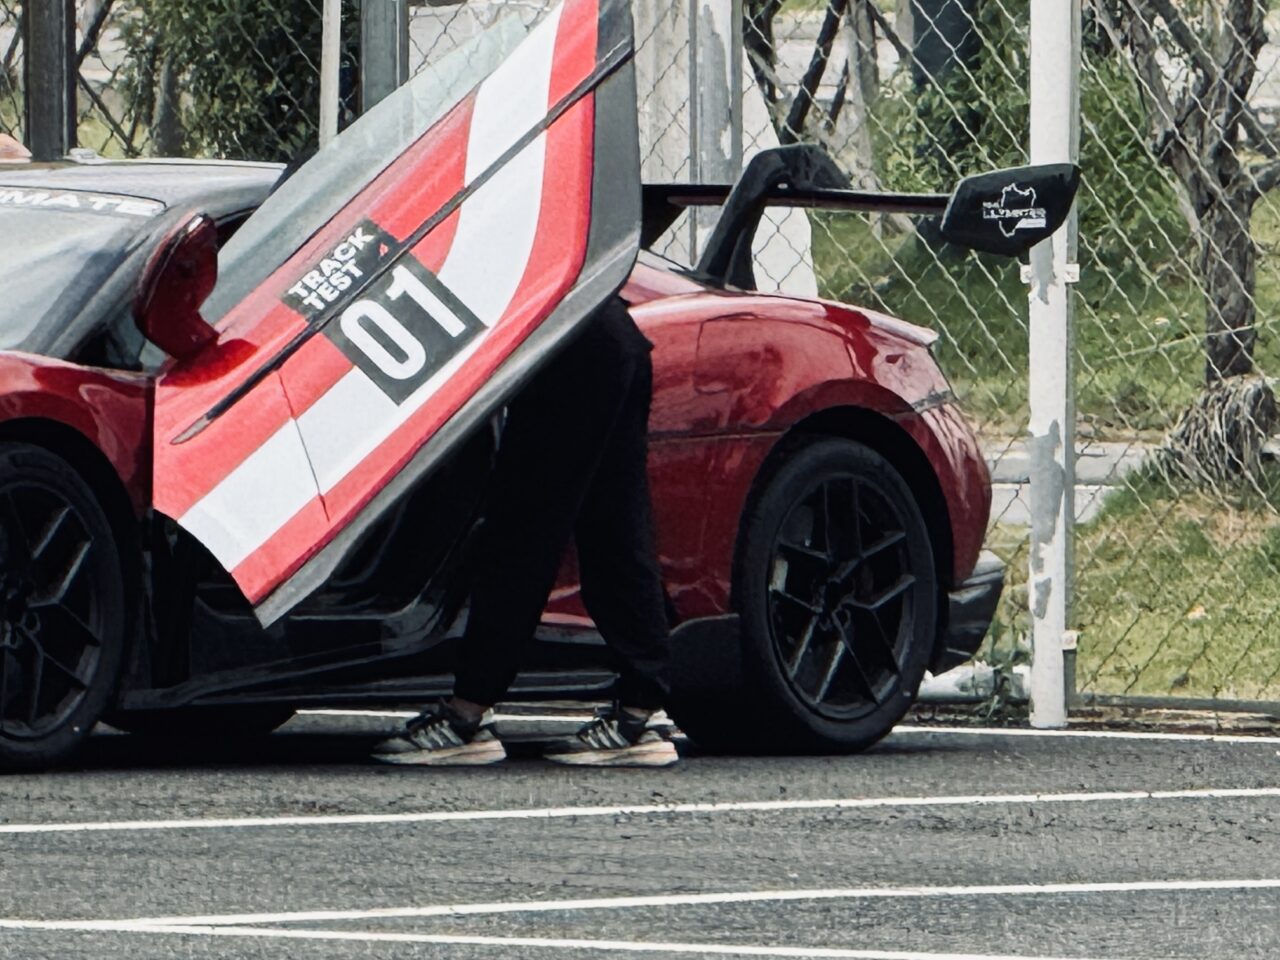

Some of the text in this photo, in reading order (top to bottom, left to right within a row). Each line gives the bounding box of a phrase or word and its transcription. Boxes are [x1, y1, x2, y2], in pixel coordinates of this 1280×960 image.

[288, 227, 375, 299] TRACK
[302, 259, 364, 311] TEST
[340, 264, 467, 380] 01
